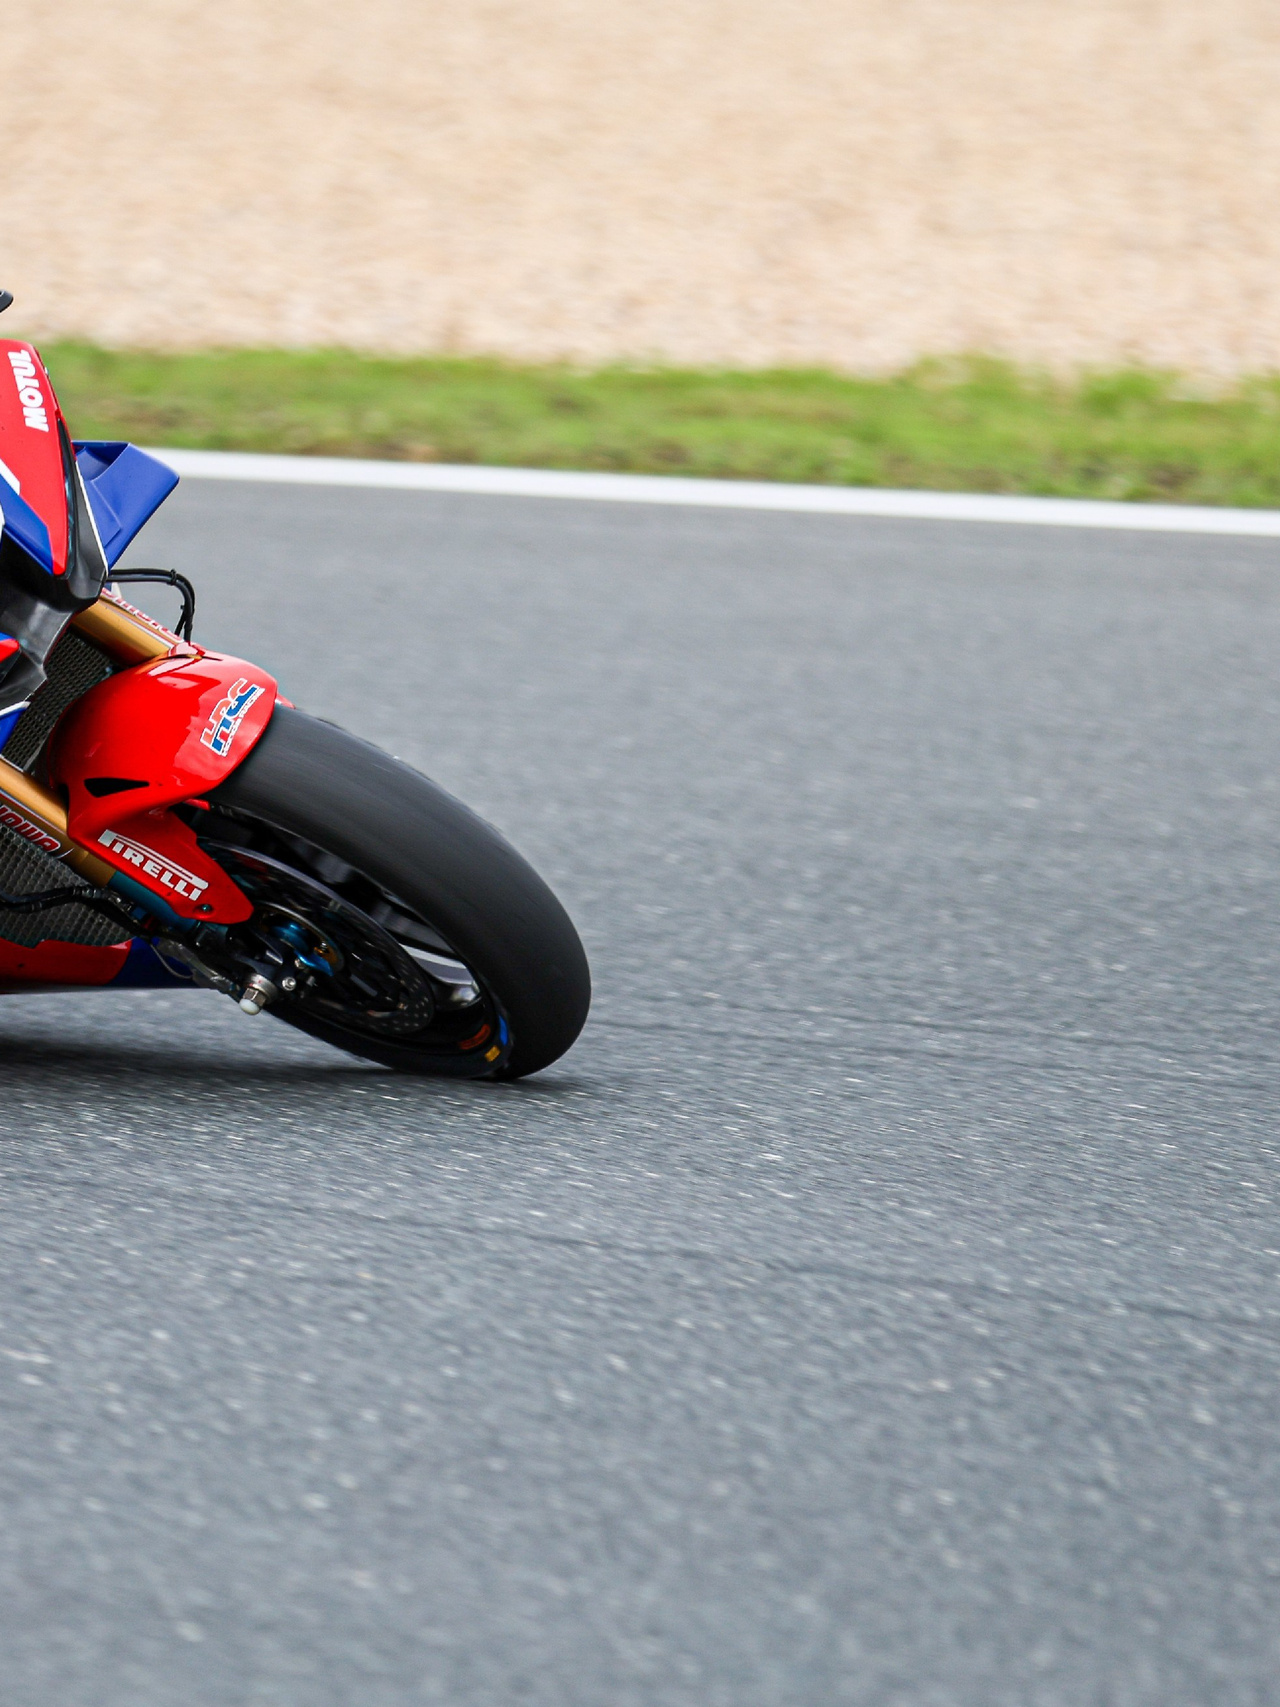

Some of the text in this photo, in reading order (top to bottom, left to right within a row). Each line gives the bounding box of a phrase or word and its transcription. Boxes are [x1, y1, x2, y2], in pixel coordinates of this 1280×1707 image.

[7, 349, 50, 433] MOTUL
[199, 677, 261, 756] HRC
[98, 829, 209, 902] PIRELLI
